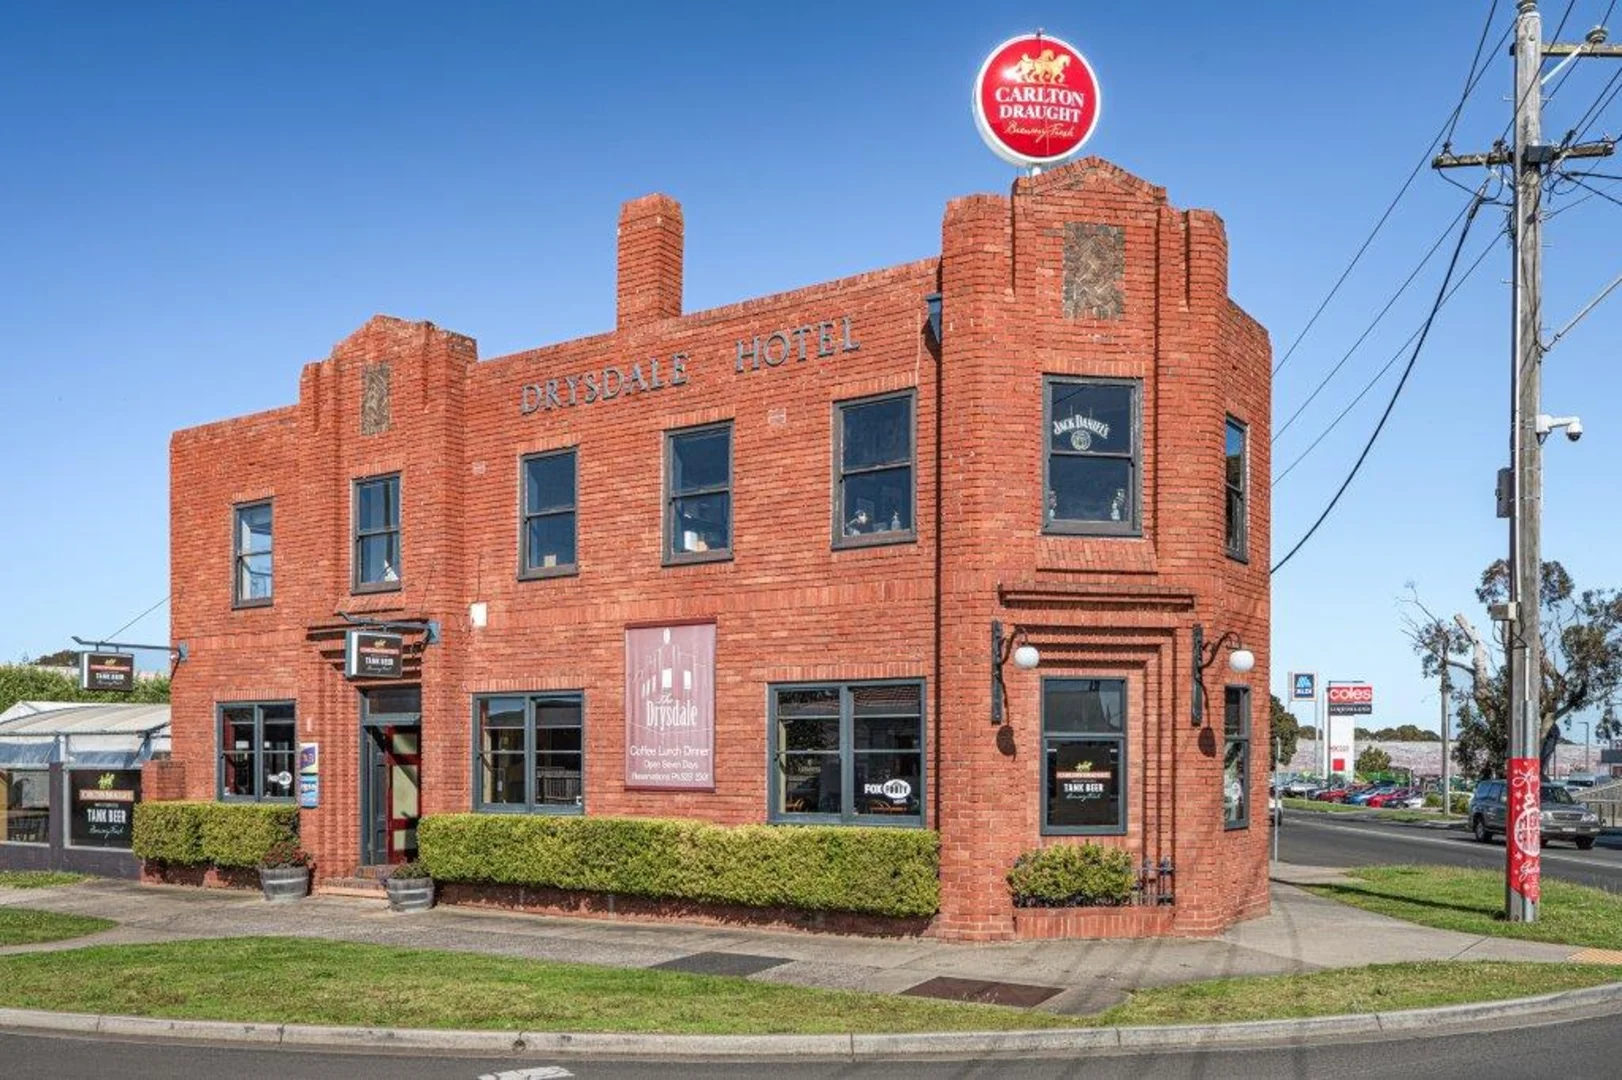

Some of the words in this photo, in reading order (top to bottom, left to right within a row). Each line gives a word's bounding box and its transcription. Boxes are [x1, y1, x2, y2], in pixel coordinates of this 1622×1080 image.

[995, 86, 1085, 108] CARLTON
[999, 104, 1081, 123] DRAUGHT
[520, 352, 690, 415] DRYSDALE
[735, 315, 861, 373] HOTEL
[1053, 417, 1075, 435] JACK
[1330, 686, 1371, 700] coles
[646, 700, 698, 731] Drysdale
[630, 745, 656, 756] Coffee
[658, 745, 681, 756] Lunch
[684, 745, 710, 756] Dinner
[864, 783, 883, 795] FOX
[1063, 783, 1084, 793] TANK
[1085, 783, 1104, 793] BEER
[87, 808, 107, 823] TANK
[108, 809, 126, 824] BEER
